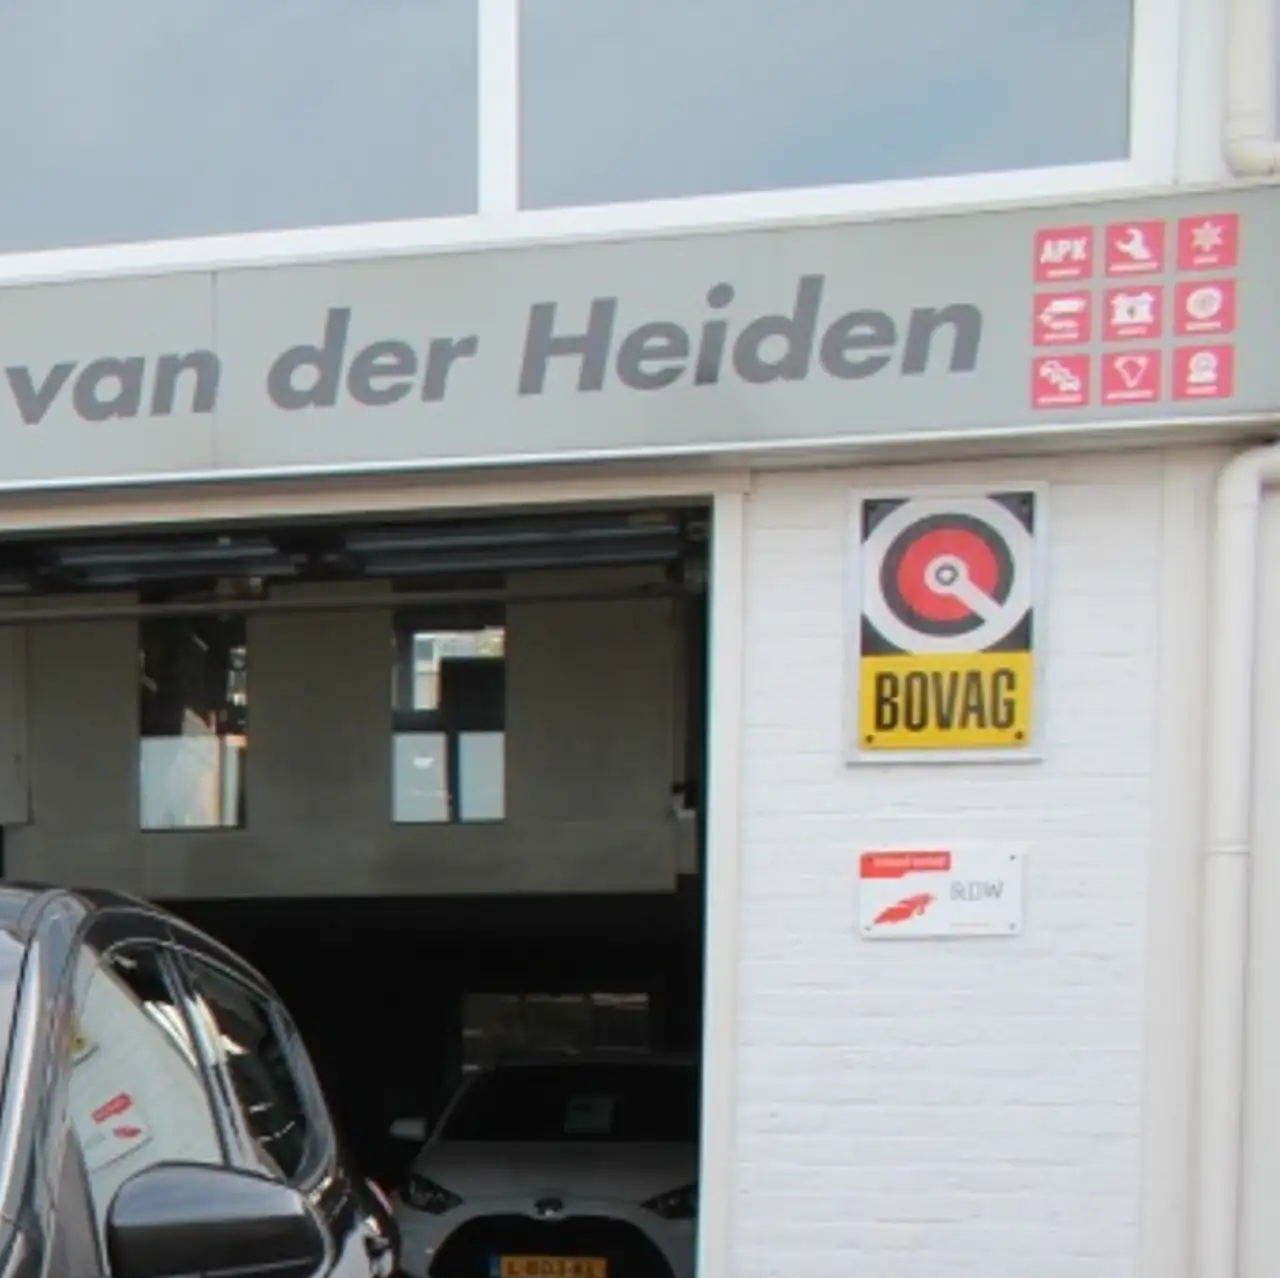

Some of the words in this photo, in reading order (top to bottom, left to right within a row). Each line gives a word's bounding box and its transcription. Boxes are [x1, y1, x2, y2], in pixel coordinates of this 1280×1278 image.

[6, 348, 221, 427] van
[265, 306, 477, 411] der
[517, 275, 984, 396] Heiden
[874, 667, 1017, 732] BOVAG
